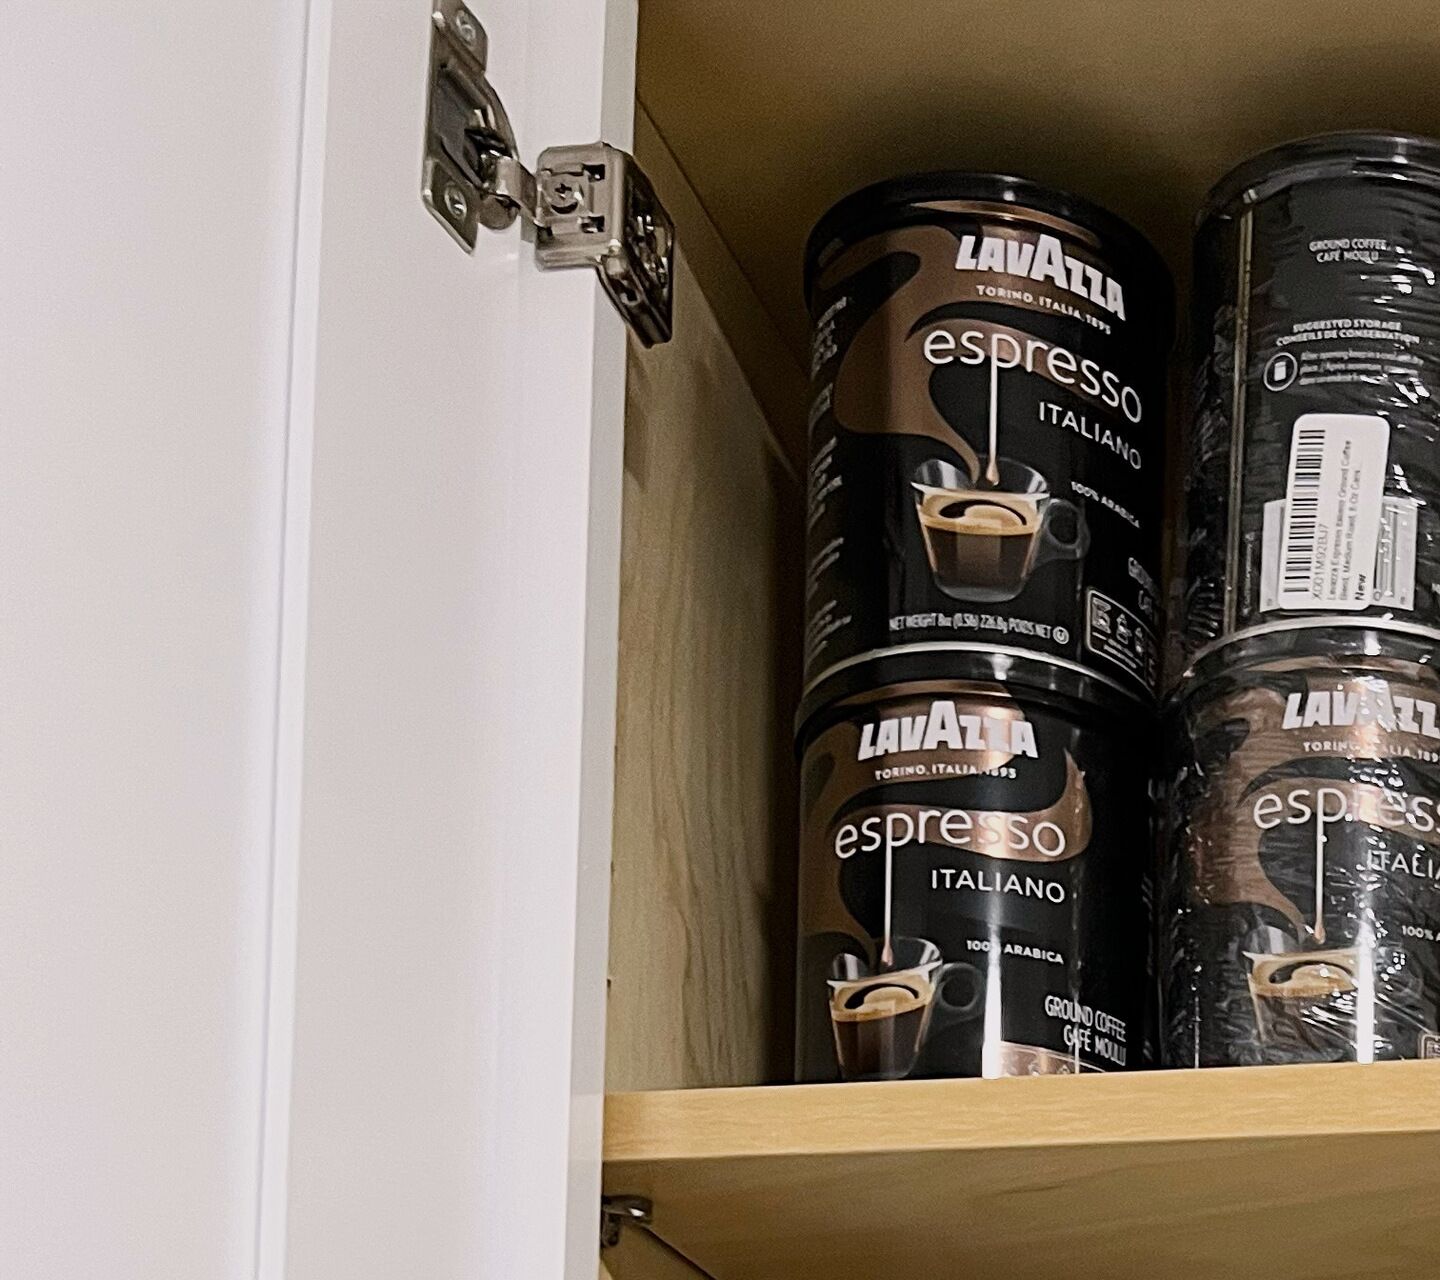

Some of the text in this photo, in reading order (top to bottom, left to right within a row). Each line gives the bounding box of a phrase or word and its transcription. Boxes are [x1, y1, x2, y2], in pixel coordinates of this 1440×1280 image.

[955, 233, 1126, 321] LAVAZZA
[923, 329, 1143, 423] espresso
[1039, 402, 1142, 469] ITALIANO
[1071, 481, 1140, 528] 100% ARABICA
[1355, 573, 1367, 601] New
[857, 700, 1039, 761] LAVAZZA
[1303, 740, 1361, 753] TORIN
[834, 808, 1066, 859] espresso
[931, 868, 1066, 903] ITALIANO
[966, 940, 1064, 965] 100 ARABICA
[1401, 924, 1434, 941] 100%
[1045, 995, 1127, 1043] GROUND COFFEE
